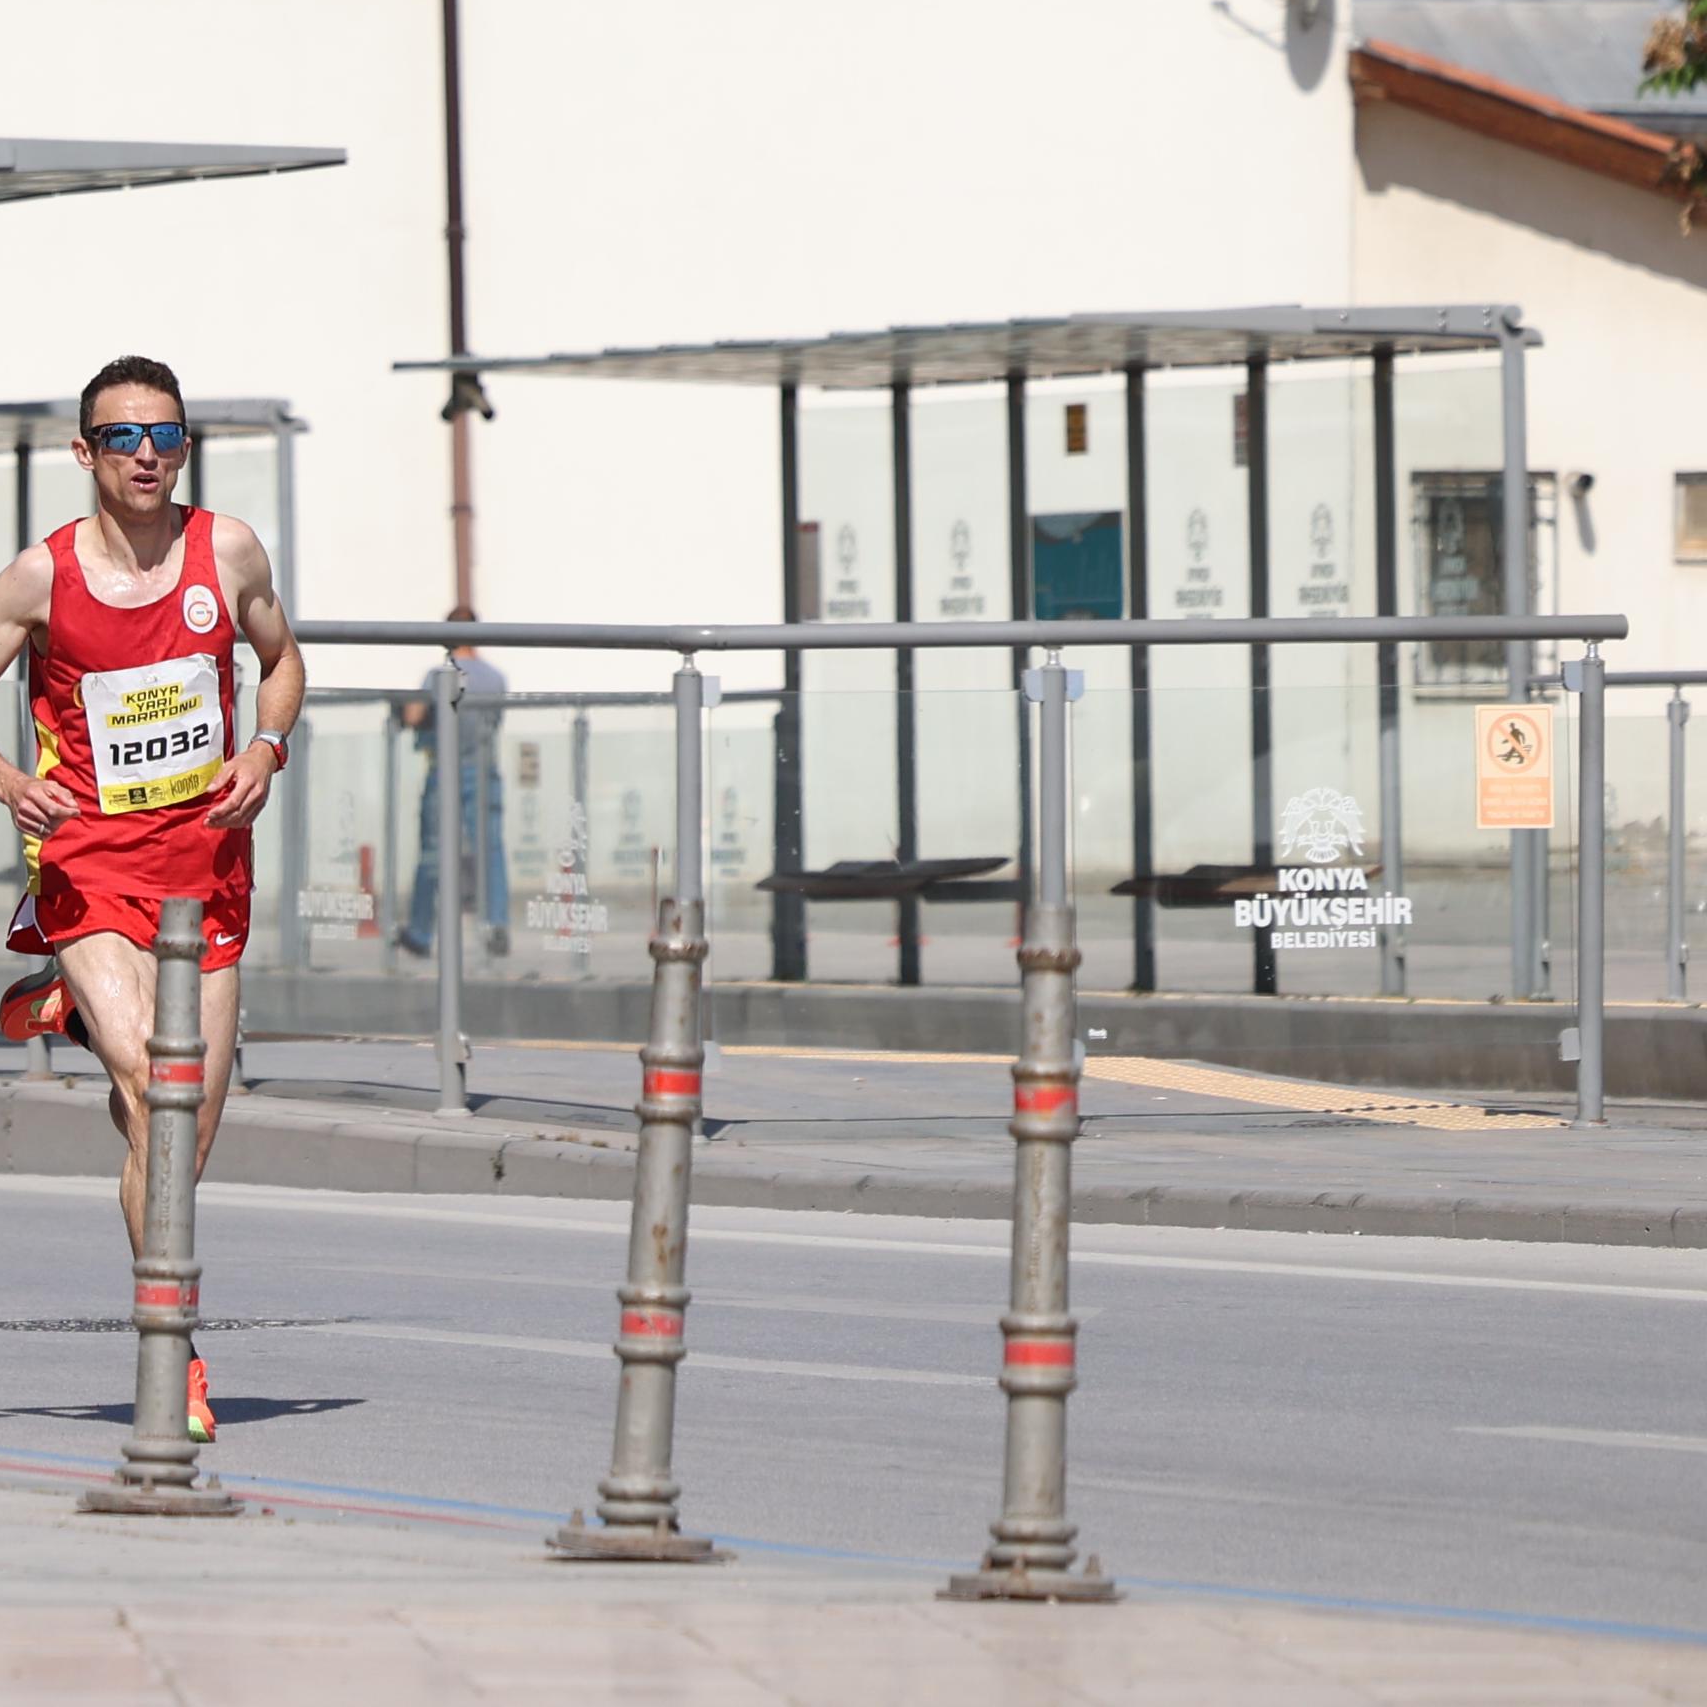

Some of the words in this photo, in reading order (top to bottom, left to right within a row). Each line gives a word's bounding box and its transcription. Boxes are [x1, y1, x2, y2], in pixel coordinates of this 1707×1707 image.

[126, 685, 179, 704] KONYA
[136, 698, 172, 712] YARI
[111, 698, 197, 725] MARATONU
[109, 723, 210, 766] 12032
[1278, 868, 1368, 892] KONYA
[1235, 891, 1413, 930] BÜYÜKŞEHİR
[1270, 927, 1376, 949] BELEDİYESİ
